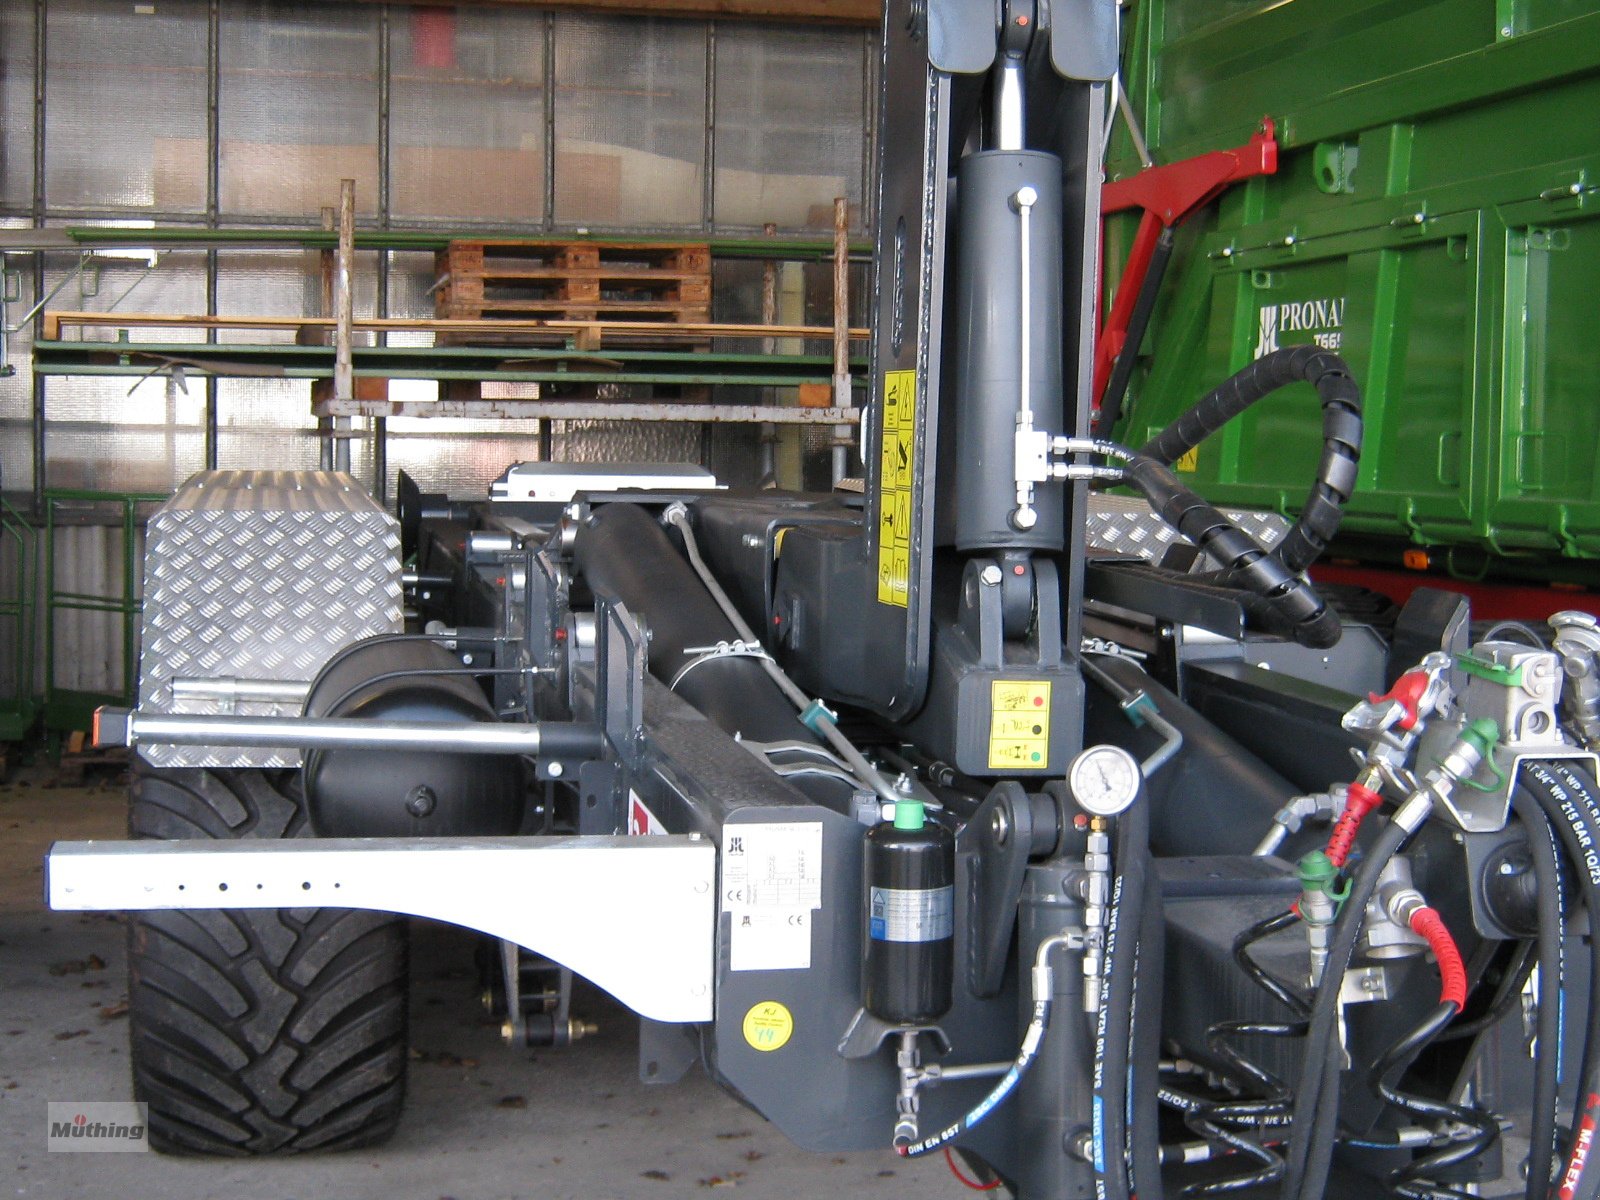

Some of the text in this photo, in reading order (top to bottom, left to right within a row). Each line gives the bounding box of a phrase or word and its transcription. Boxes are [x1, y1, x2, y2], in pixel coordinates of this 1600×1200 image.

[1566, 774, 1581, 790] WP
[1535, 770, 1555, 784] 3/4"
[1550, 784, 1567, 801] WP
[1561, 801, 1580, 821] 215
[1572, 820, 1591, 849] BAR
[1108, 906, 1119, 932] BAR
[1103, 956, 1112, 976] WP
[1098, 1004, 1107, 1035] R2AT
[1096, 1038, 1105, 1059] 100
[1094, 1062, 1103, 1089] SAE
[1157, 1089, 1188, 1109] 2Q/22
[908, 1142, 924, 1155] DIN
[925, 1137, 940, 1149] EN
[1562, 1128, 1593, 1191] M-FLEX
